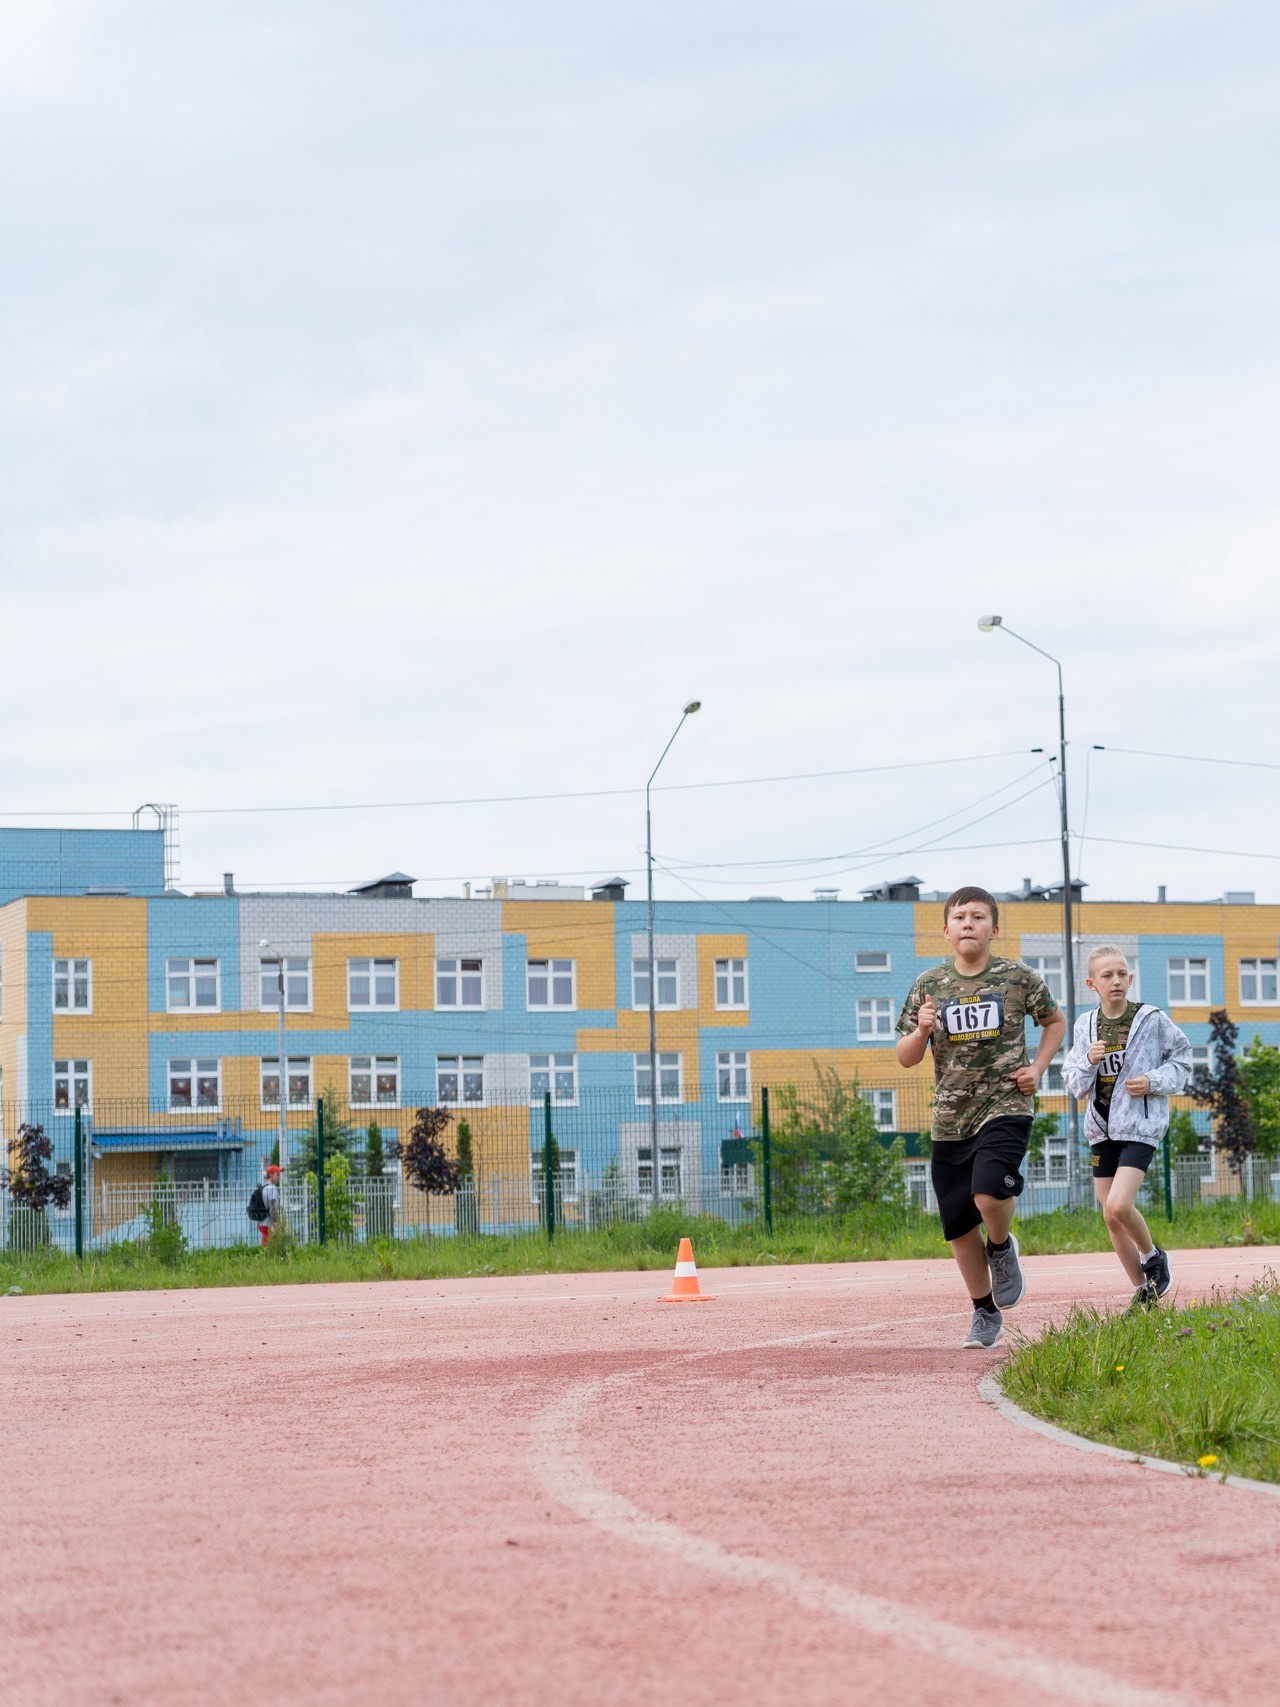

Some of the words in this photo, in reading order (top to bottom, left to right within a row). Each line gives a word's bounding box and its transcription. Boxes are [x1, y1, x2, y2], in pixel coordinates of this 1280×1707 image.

[959, 996, 981, 1004] ШКОЛА
[952, 1004, 991, 1031] 167
[949, 1032, 980, 1041] МОЛОДОГО
[981, 1029, 1000, 1038] БОЙЦА
